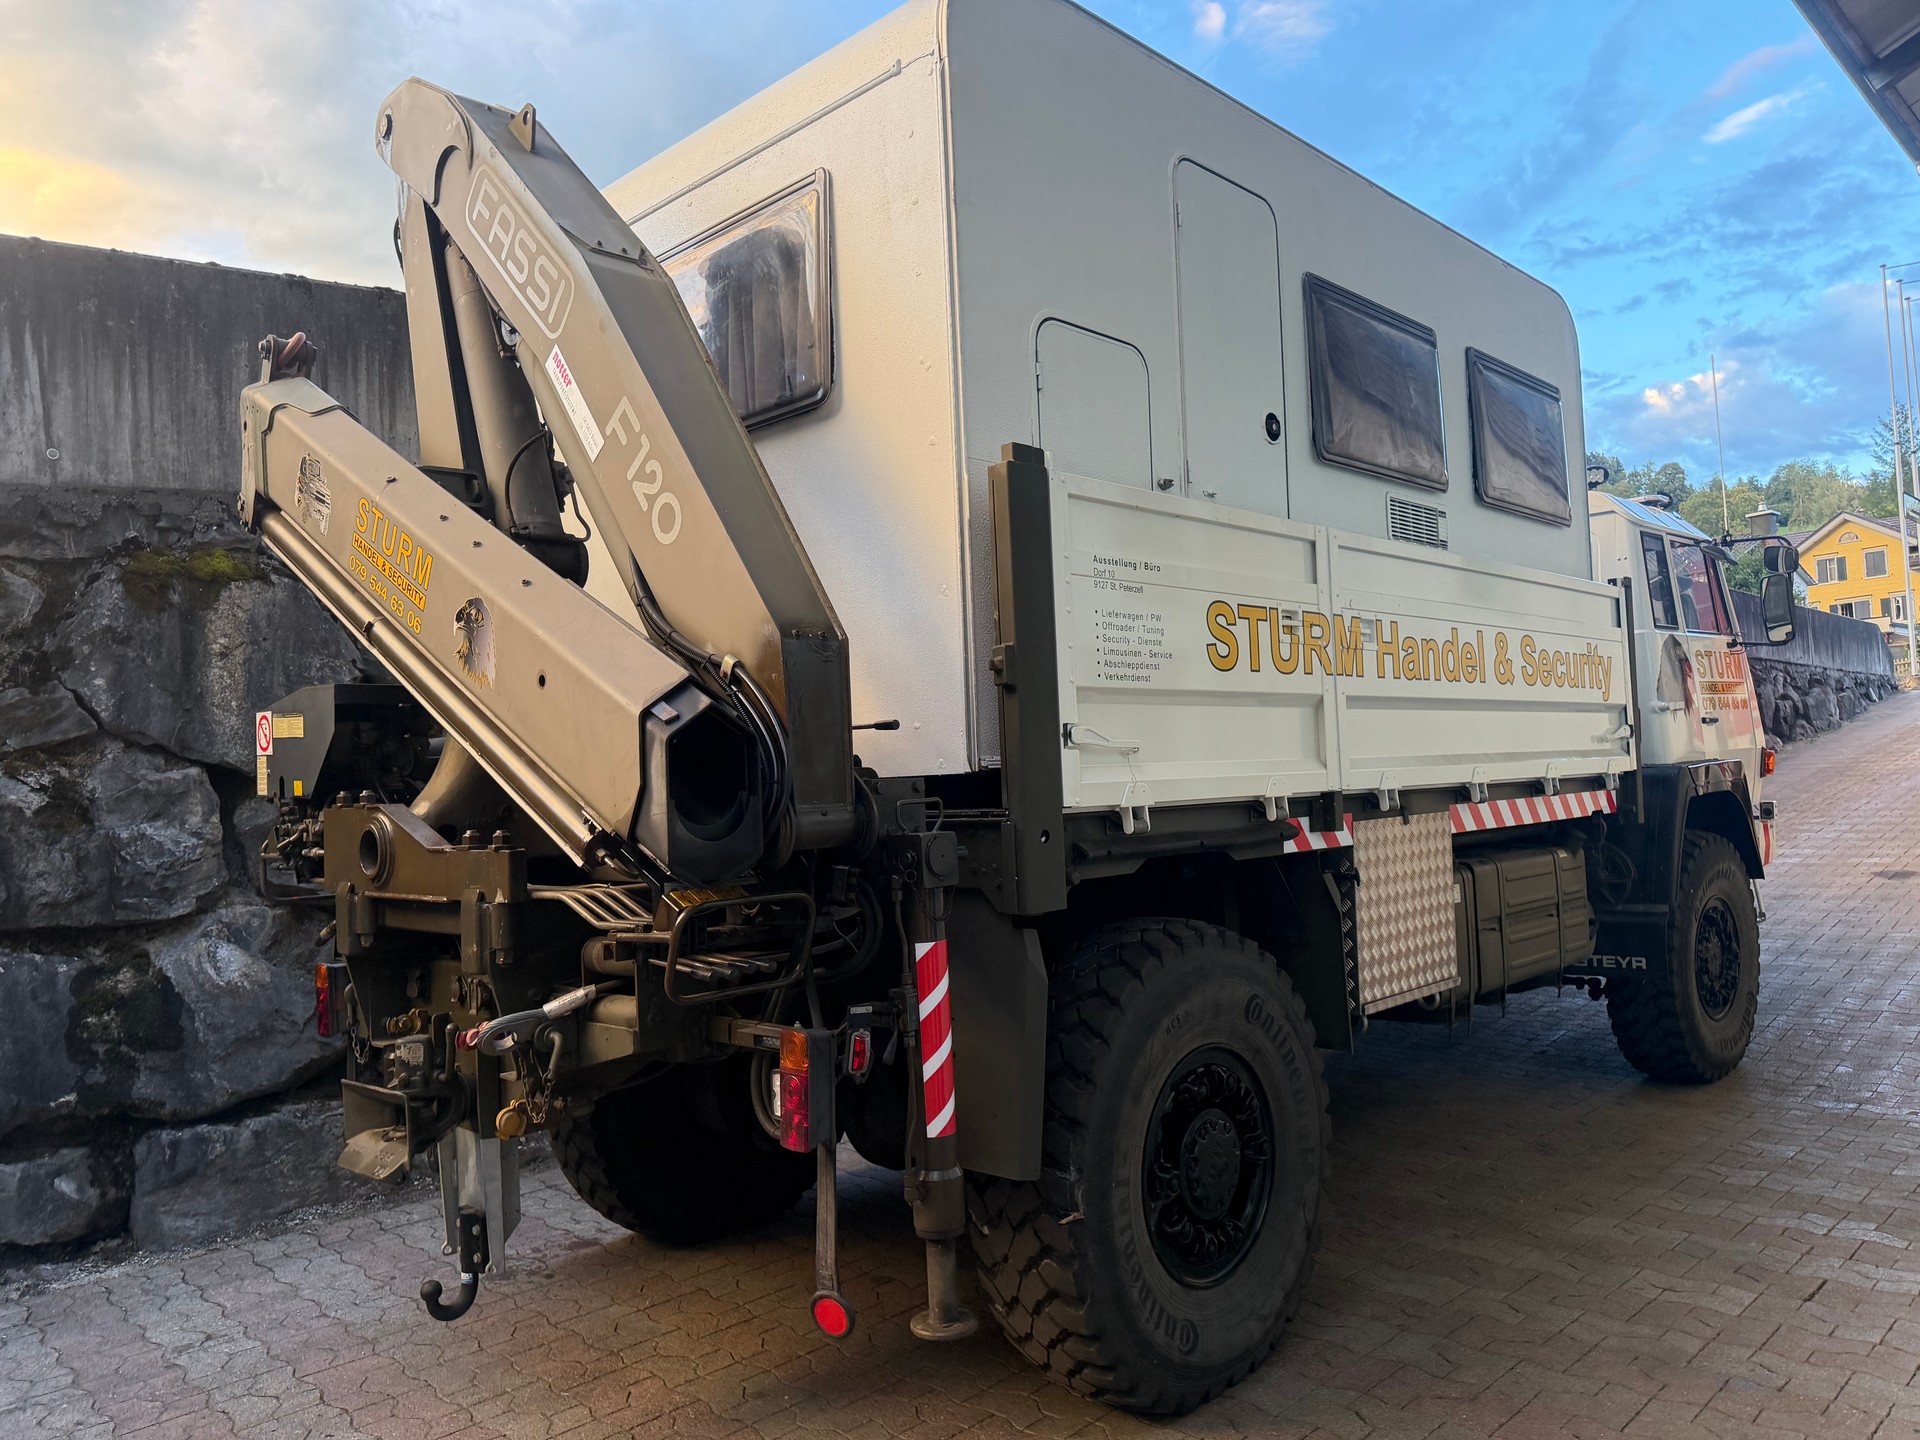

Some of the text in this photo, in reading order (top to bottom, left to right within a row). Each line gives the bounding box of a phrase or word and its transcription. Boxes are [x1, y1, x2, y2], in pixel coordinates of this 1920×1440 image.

[472, 178, 567, 324] FASSI
[552, 351, 572, 388] notter
[605, 395, 682, 545] F120
[356, 497, 434, 591] STURM
[353, 535, 425, 607] HANDEL & SECURITY
[1092, 555, 1138, 571] Ausstellung
[1144, 562, 1161, 572] Büro
[1093, 567, 1116, 579] Dorf 10
[349, 554, 422, 635] 079 544 63 06
[1093, 580, 1144, 594] 9127 St. Peterzell
[1101, 609, 1144, 622] Lieferwagen
[1150, 613, 1162, 623] PW
[1101, 621, 1136, 633] Offroader
[1142, 625, 1165, 637] Tuning
[1102, 634, 1130, 646] Security
[1137, 637, 1163, 647] Dienste
[1103, 647, 1142, 658] Limousinen
[1148, 650, 1173, 660] Service
[1206, 600, 1613, 702] STURM Handel & Security
[1103, 660, 1161, 671] Abschleppdienst
[1695, 649, 1744, 679] STURM
[1104, 672, 1151, 683] Verkehrdienst
